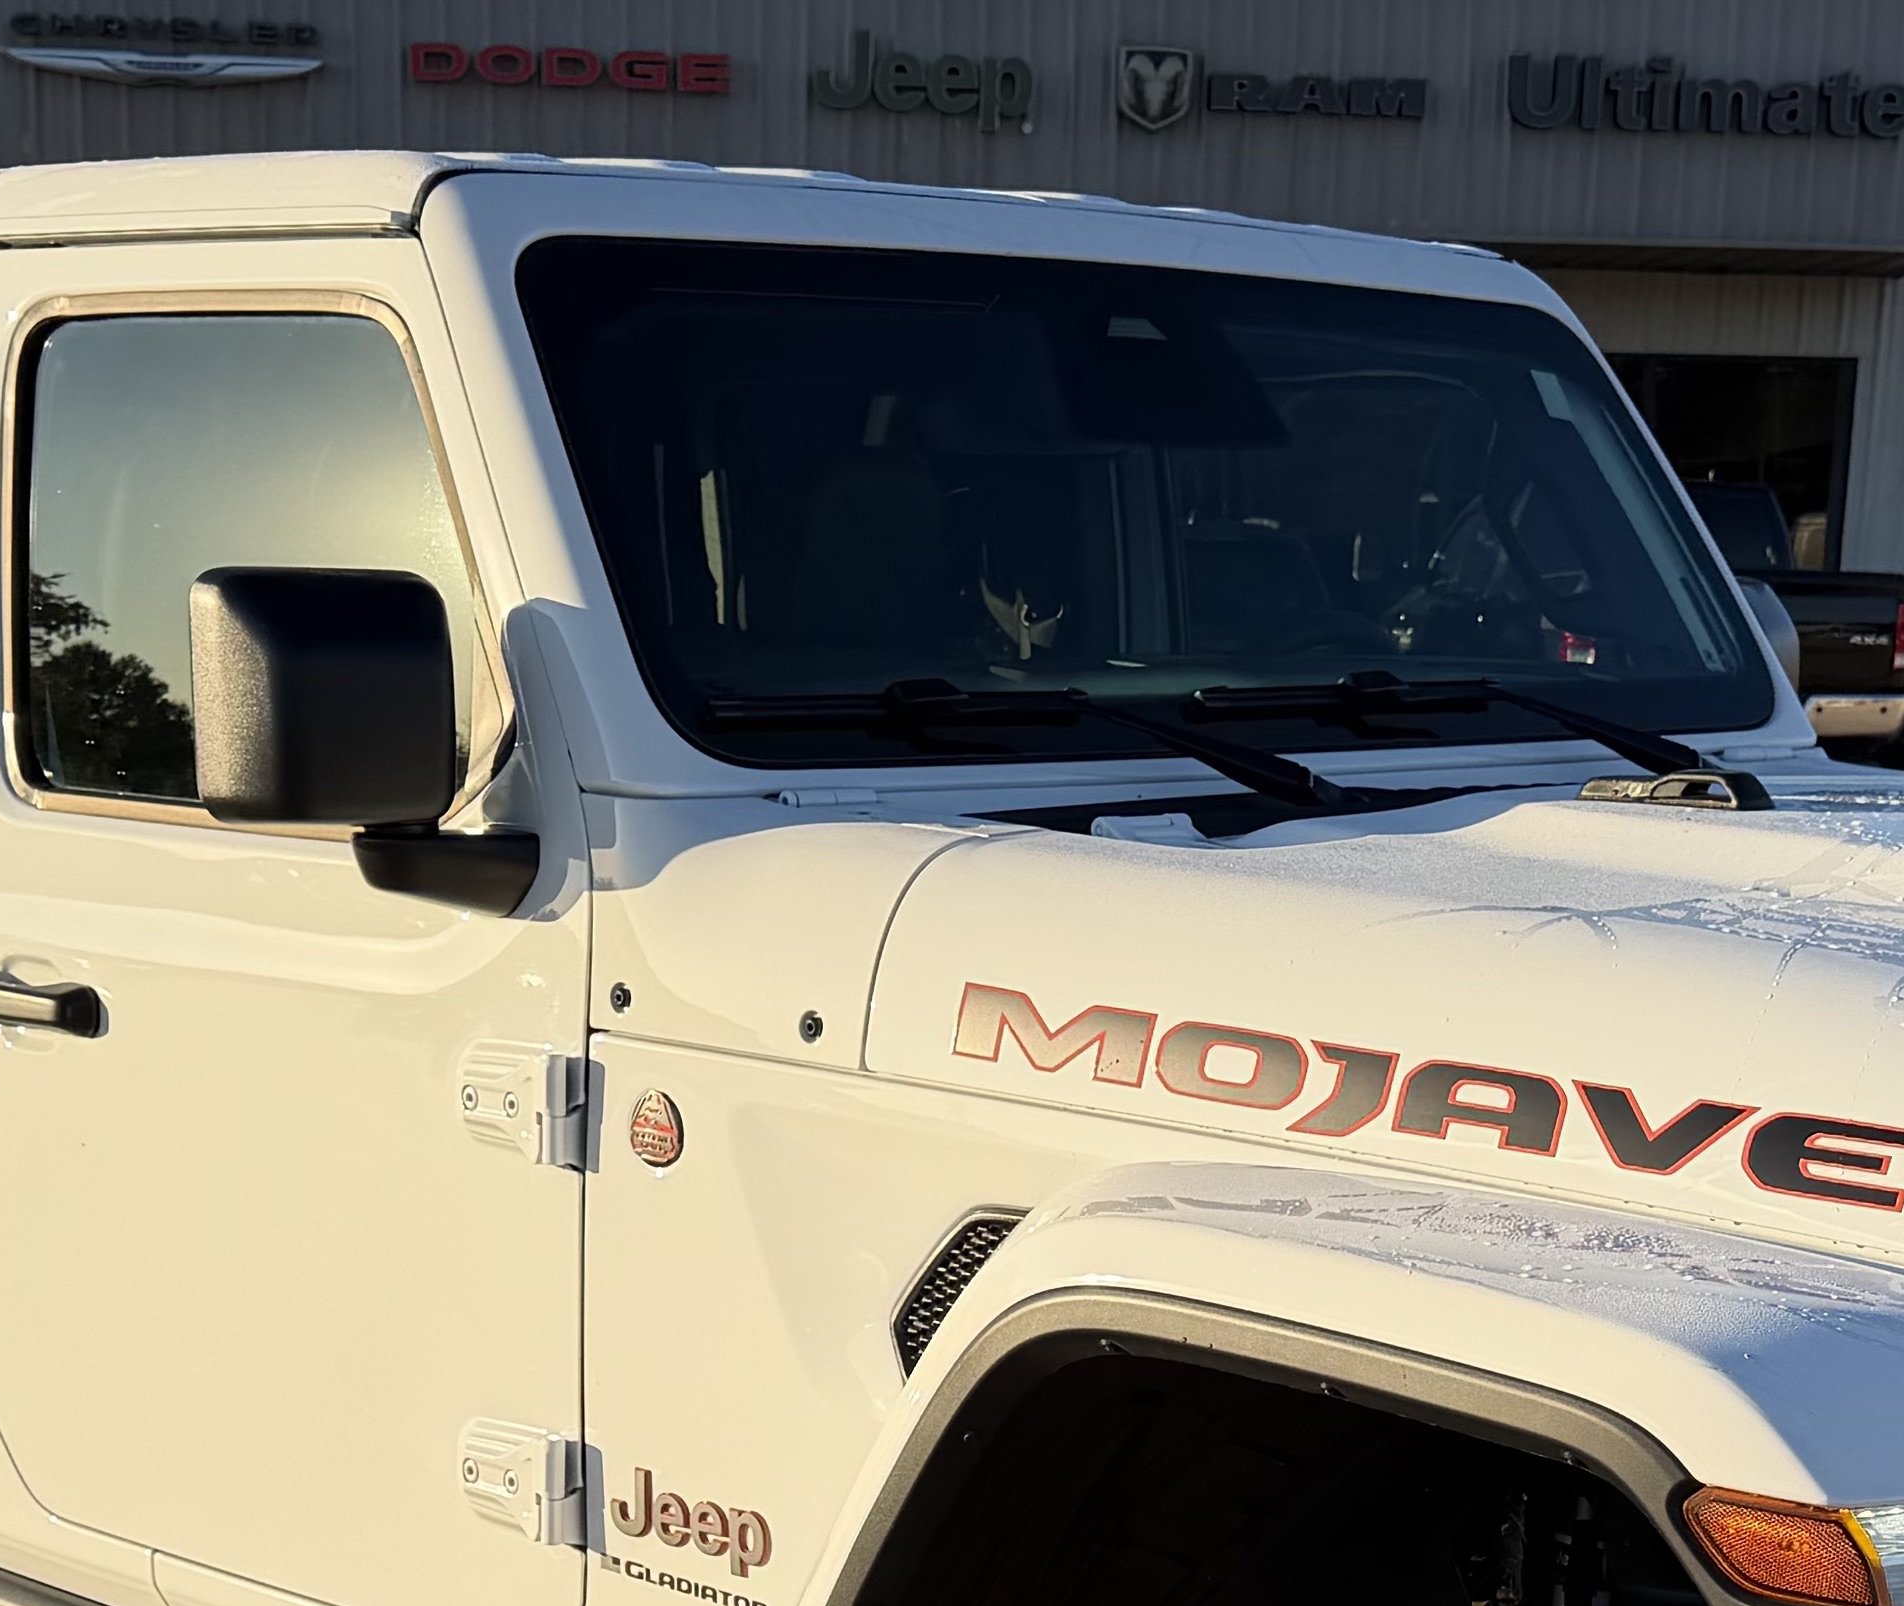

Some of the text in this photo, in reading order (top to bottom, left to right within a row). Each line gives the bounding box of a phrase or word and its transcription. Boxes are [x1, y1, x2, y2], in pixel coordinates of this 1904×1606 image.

[10, 12, 320, 47] CHRYSLER
[409, 42, 731, 94] DODGE
[808, 29, 1034, 134] Jeep
[1207, 74, 1426, 119] RAM
[610, 1466, 772, 1578] Jeep
